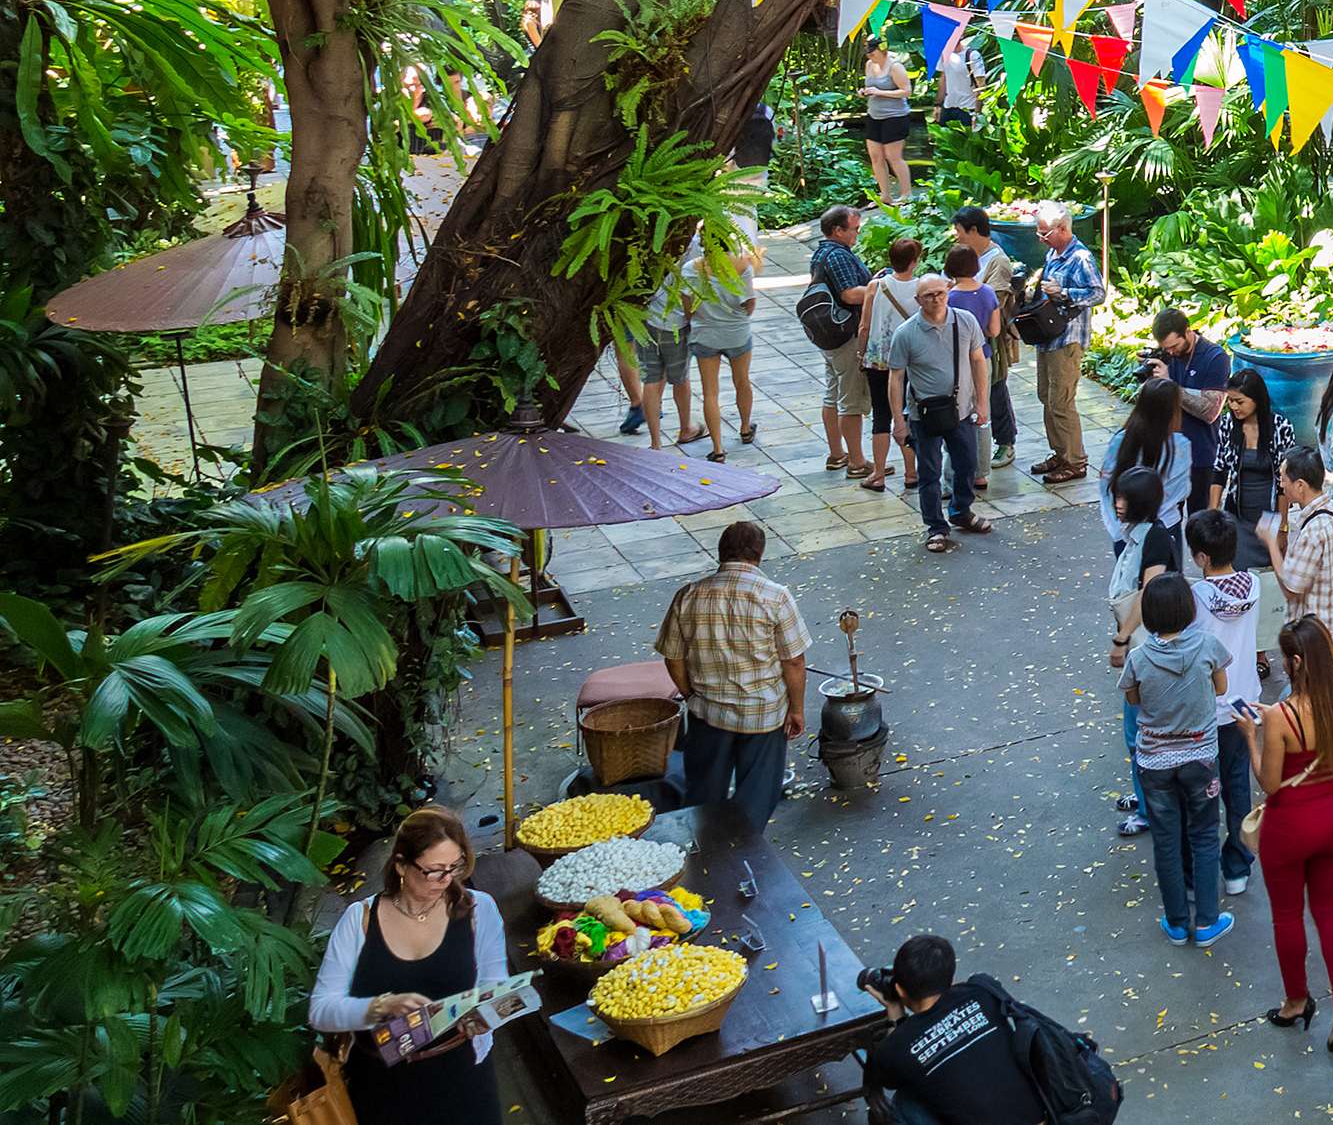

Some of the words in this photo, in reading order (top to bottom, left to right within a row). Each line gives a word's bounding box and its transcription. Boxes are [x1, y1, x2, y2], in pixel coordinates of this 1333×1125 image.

[910, 1001, 981, 1055] CELEBRATES
[917, 1011, 986, 1064] SEPTEMBER
[967, 1018, 989, 1035] LONG
